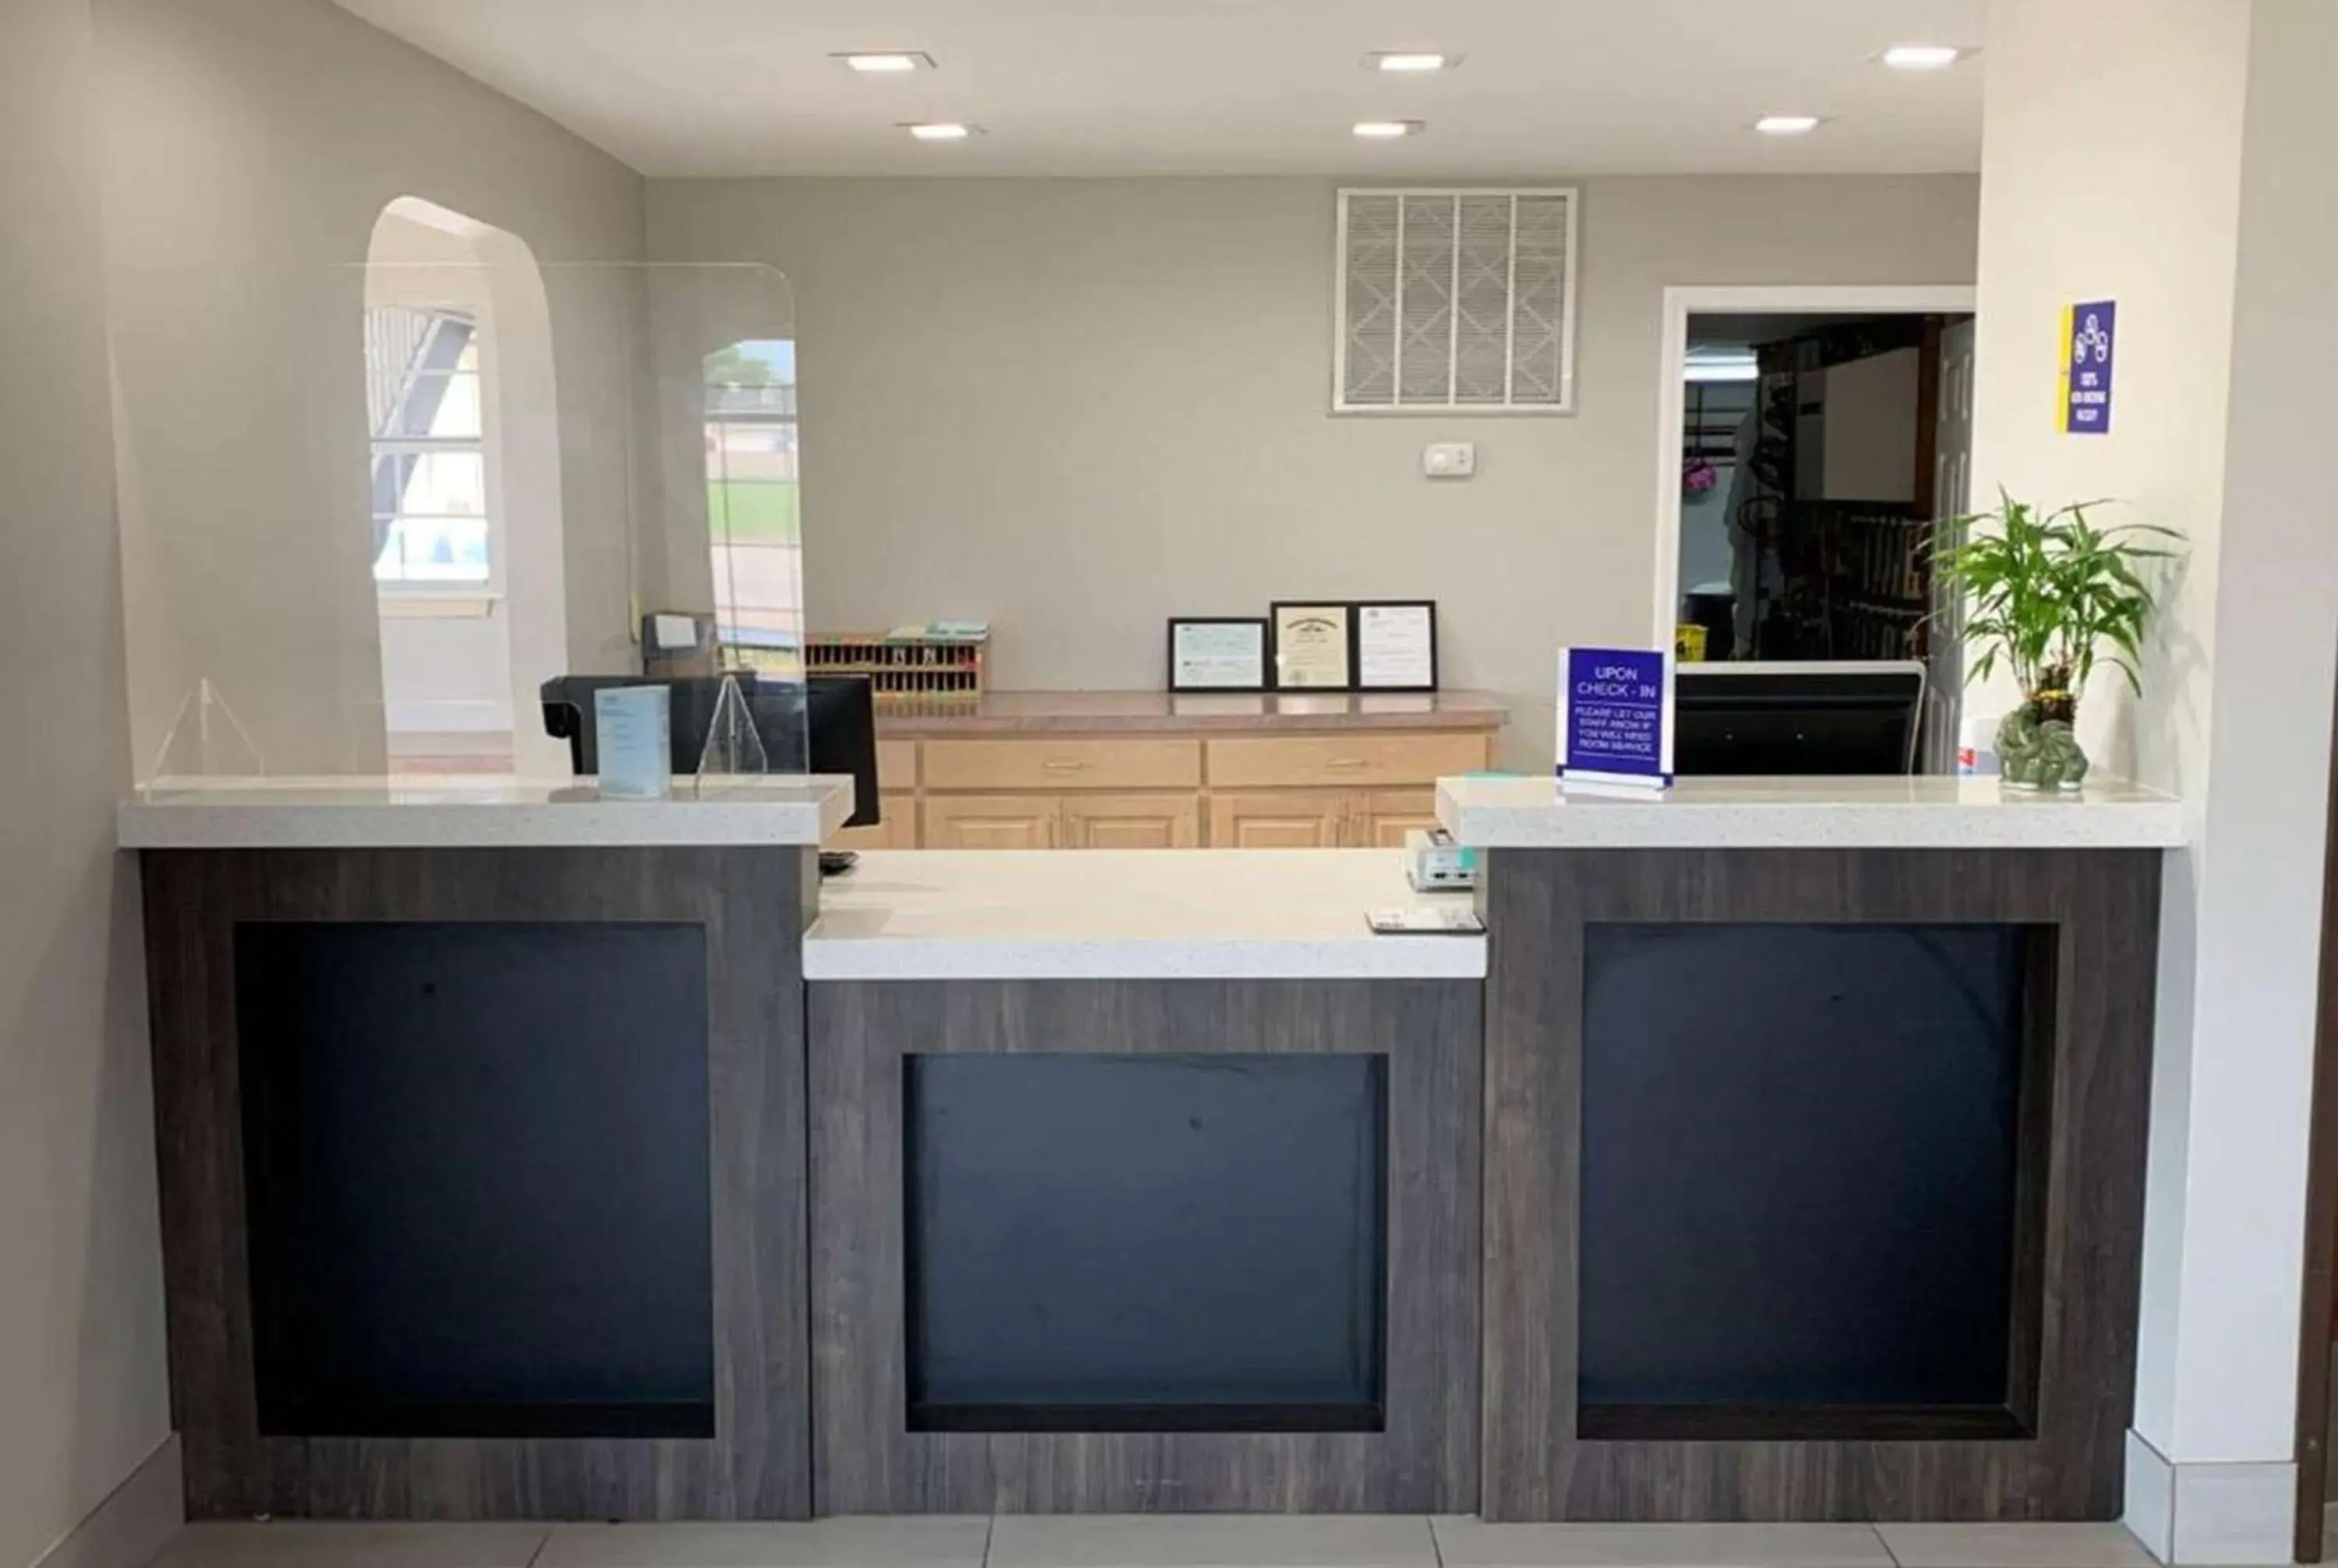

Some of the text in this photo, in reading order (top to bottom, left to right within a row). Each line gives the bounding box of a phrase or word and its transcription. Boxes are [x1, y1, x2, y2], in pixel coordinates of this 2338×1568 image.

[1595, 667, 1637, 680] UPON
[1577, 681, 1628, 697] CHECK
[1640, 684, 1655, 697] IN
